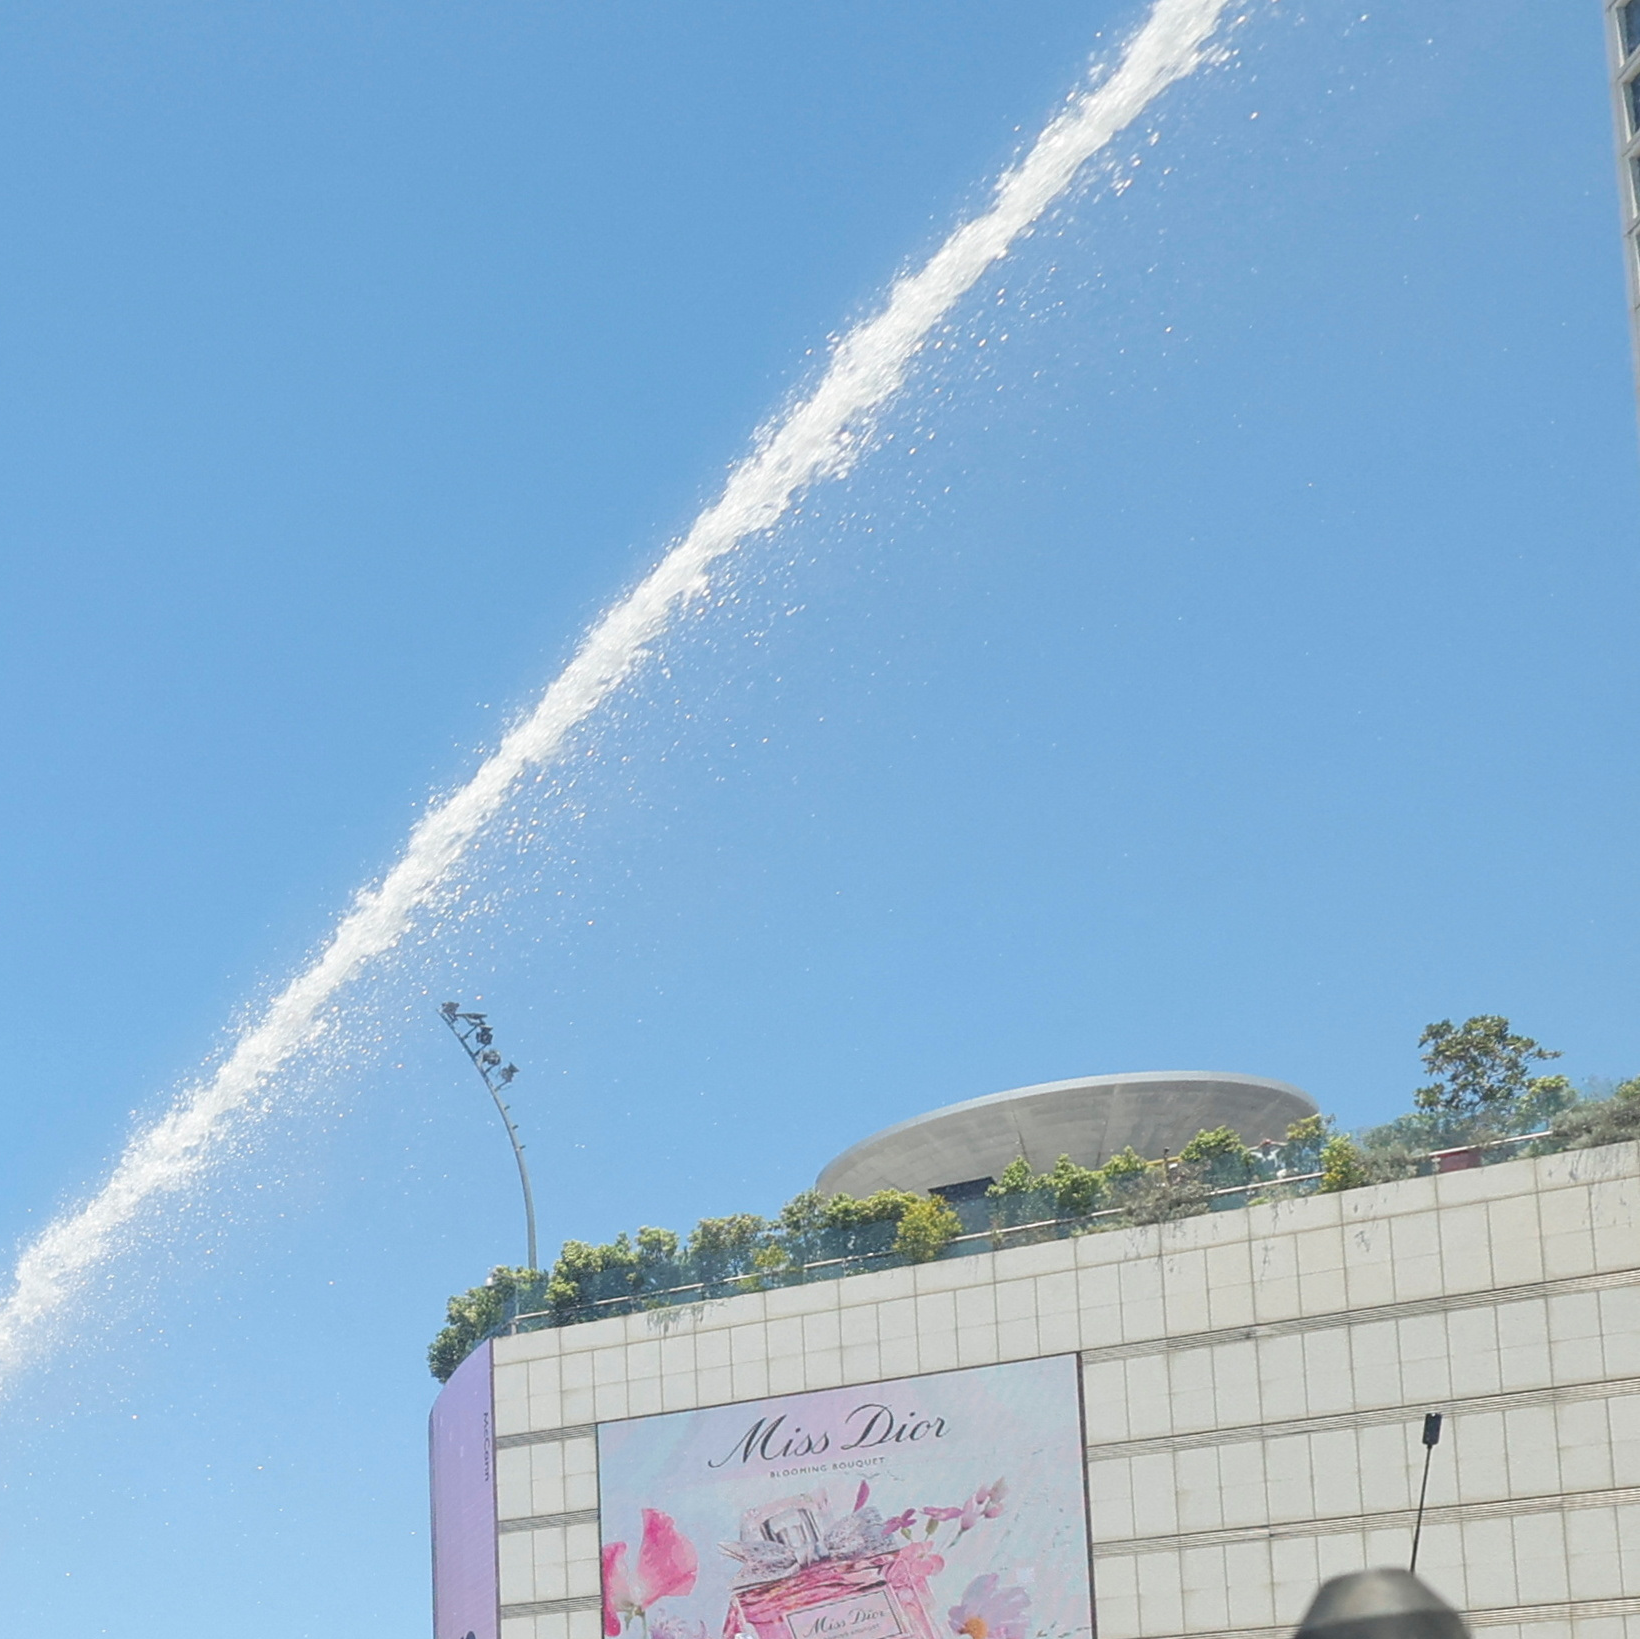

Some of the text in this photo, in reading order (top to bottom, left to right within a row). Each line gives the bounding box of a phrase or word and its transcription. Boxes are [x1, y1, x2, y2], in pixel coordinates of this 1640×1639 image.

[708, 1403, 950, 1468] Miss Dior
[770, 1456, 886, 1479] BLOOMING BOUQUET
[803, 1615, 846, 1638] Miss
[849, 1608, 885, 1625] Dior
